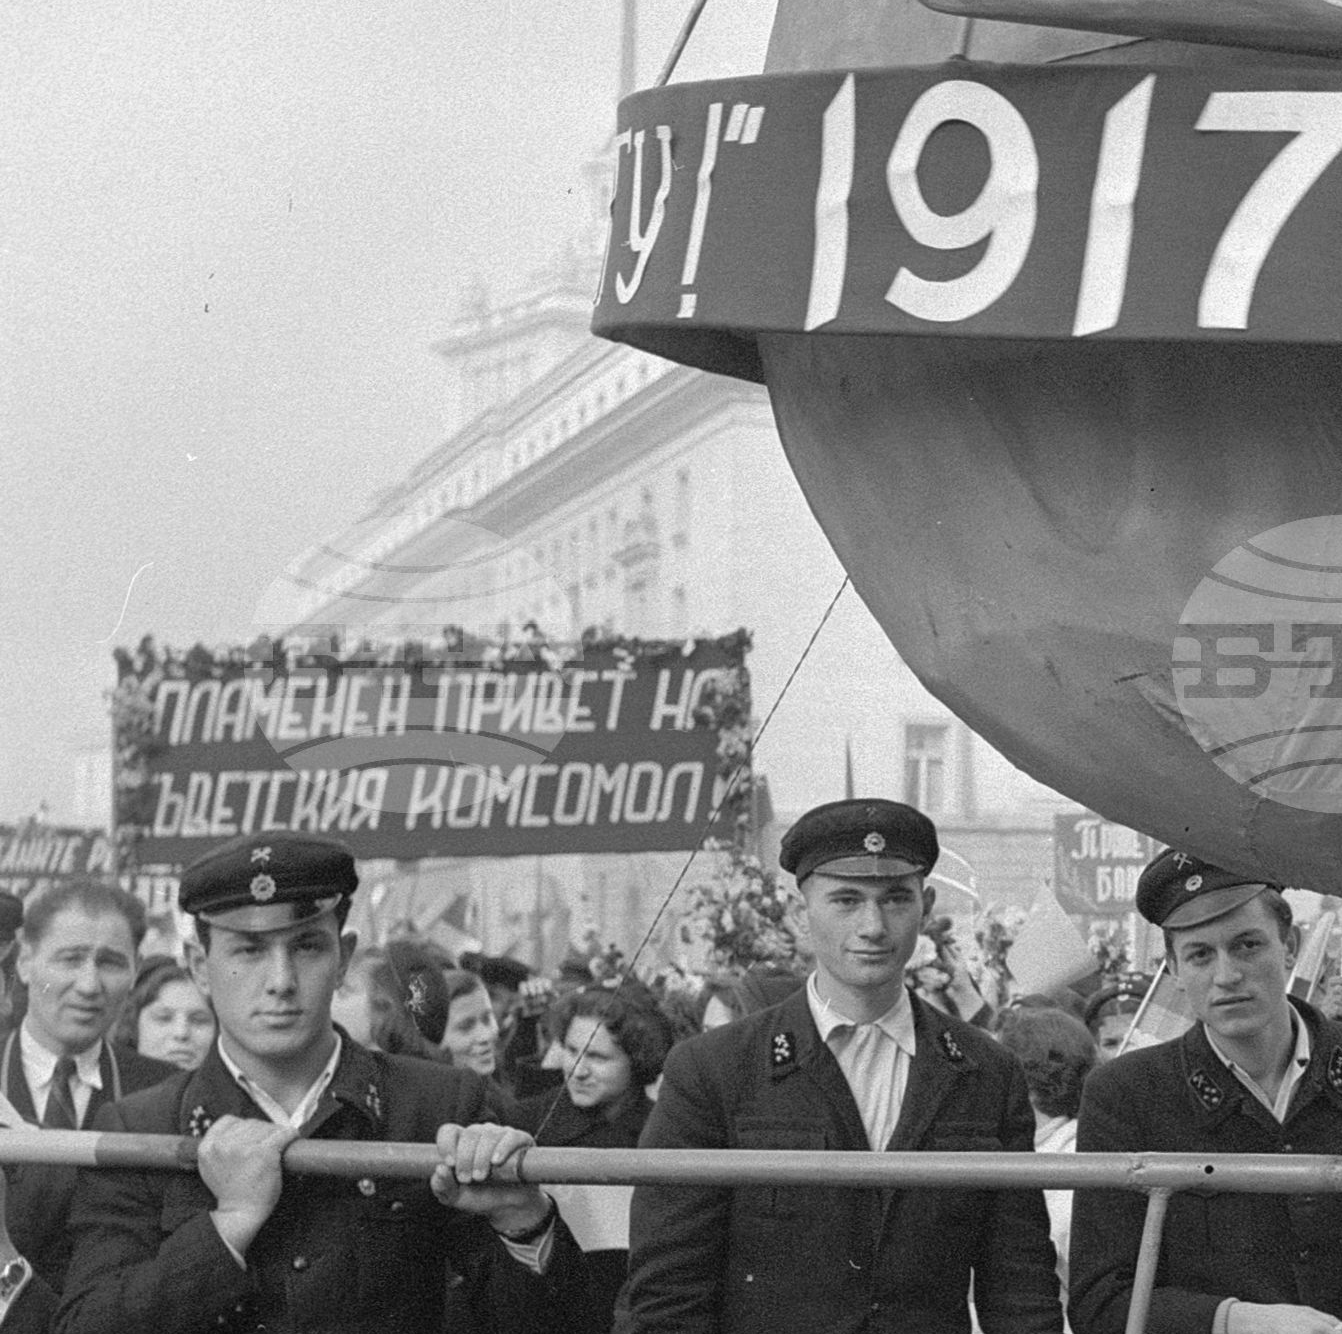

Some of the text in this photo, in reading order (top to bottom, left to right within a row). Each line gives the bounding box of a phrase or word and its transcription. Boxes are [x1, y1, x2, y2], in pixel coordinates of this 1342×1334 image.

[153, 674, 412, 746] ПЛАМЕНЕН
[433, 669, 637, 734] ПРИВЕТ
[143, 766, 389, 839] ЪВЕТСКИЯ
